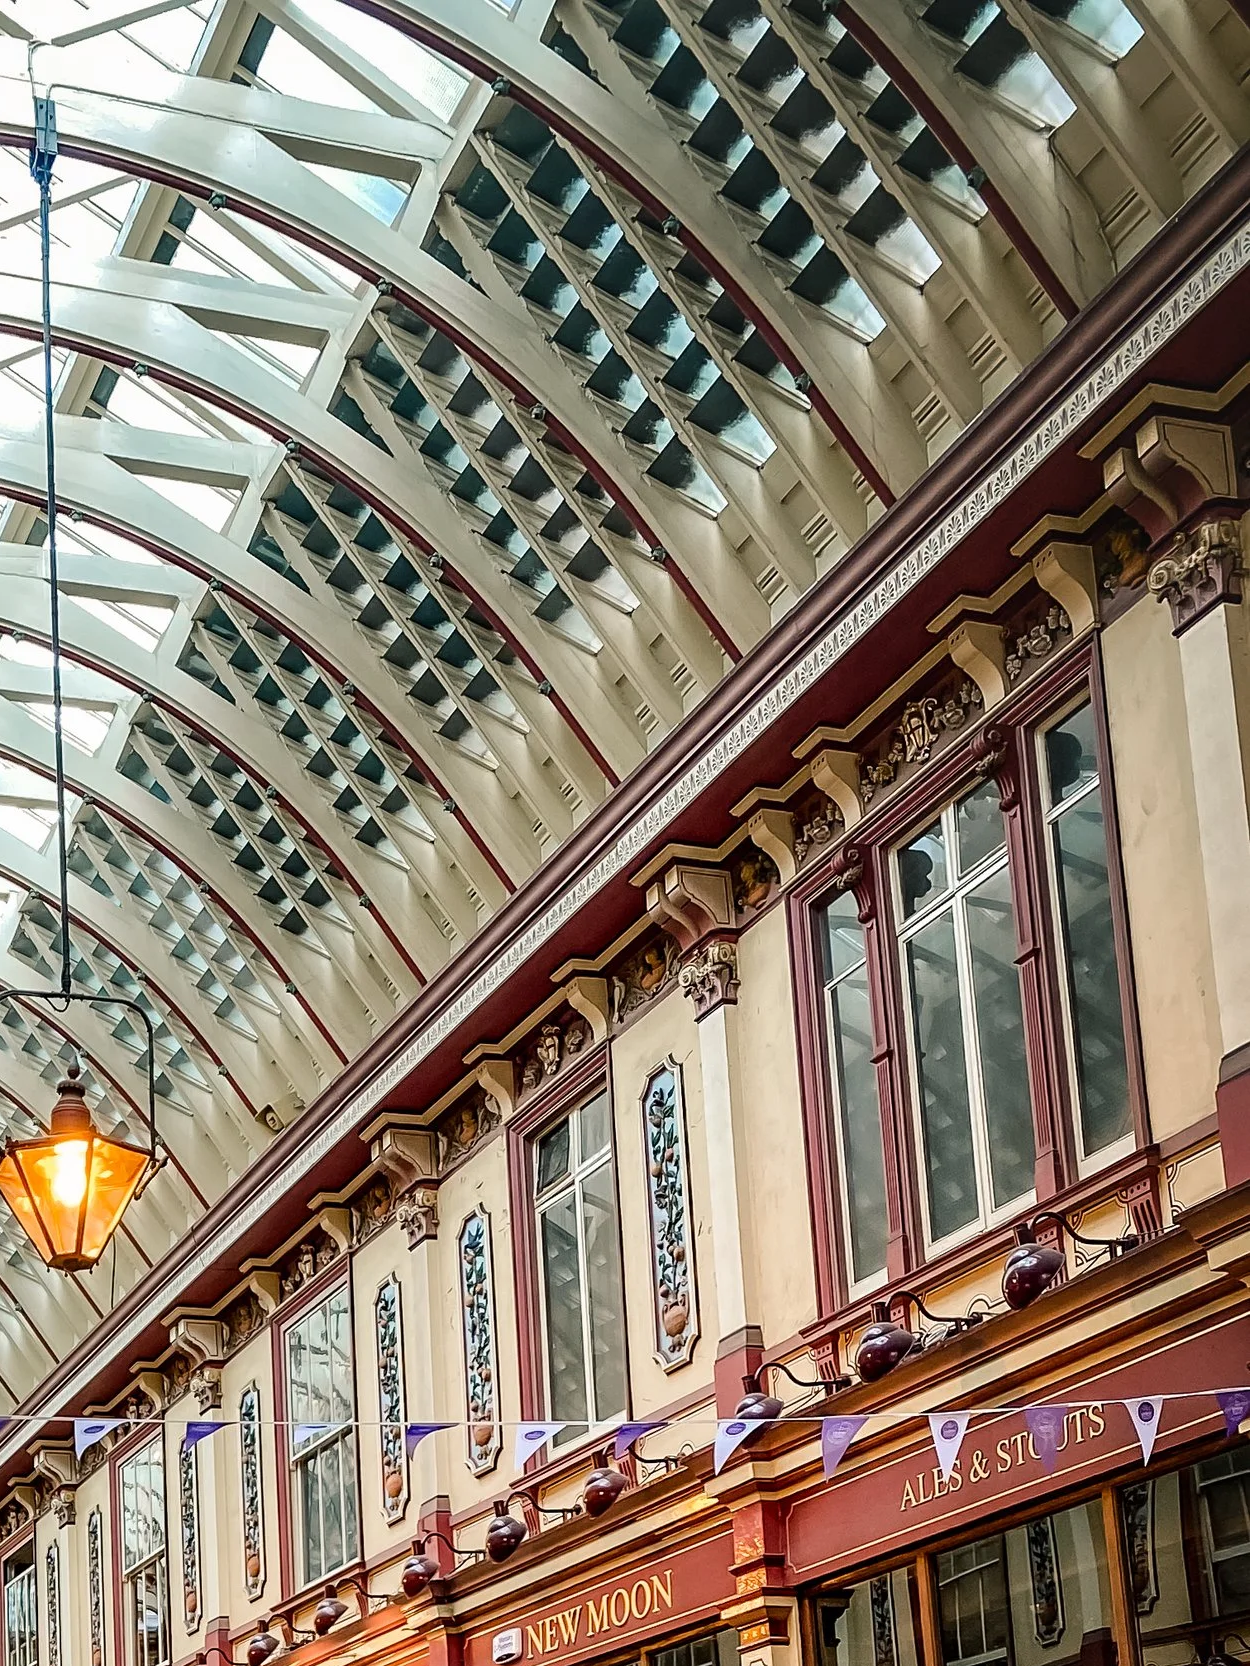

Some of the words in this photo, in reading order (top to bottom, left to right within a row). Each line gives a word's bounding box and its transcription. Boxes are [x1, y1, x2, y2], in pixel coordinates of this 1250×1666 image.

[969, 1450, 991, 1482] &
[525, 1604, 583, 1660] NEW
[586, 1570, 674, 1637] MOON
